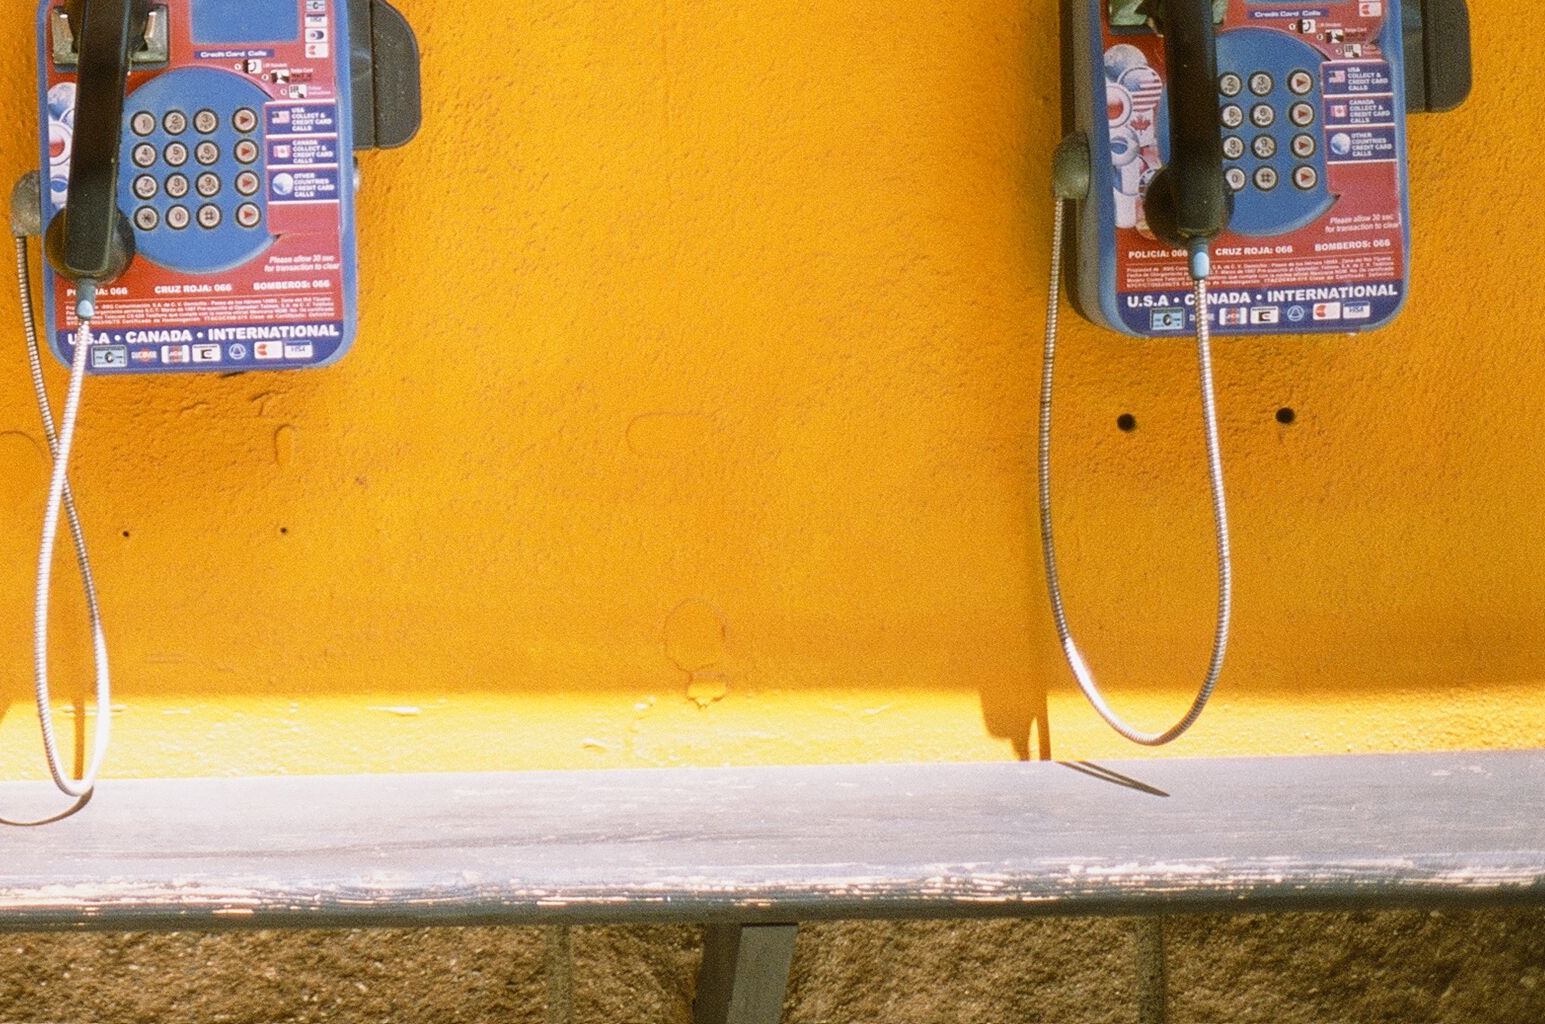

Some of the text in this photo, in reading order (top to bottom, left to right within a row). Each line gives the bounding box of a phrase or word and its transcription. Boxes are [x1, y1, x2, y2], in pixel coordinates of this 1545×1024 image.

[1215, 245, 1293, 256] CRUZ ROJA: 066
[1314, 239, 1391, 252] BOMBEROS: 066
[1128, 250, 1170, 259] POLICIA:
[154, 284, 232, 294] CRUZ ROJA: 066
[253, 280, 311, 290] BOMBEROS:
[1127, 284, 1398, 308] U.S.A CNADA INTERNATIONAL
[125, 330, 192, 343] CANADA
[208, 324, 339, 341] INTERNATIONAL
